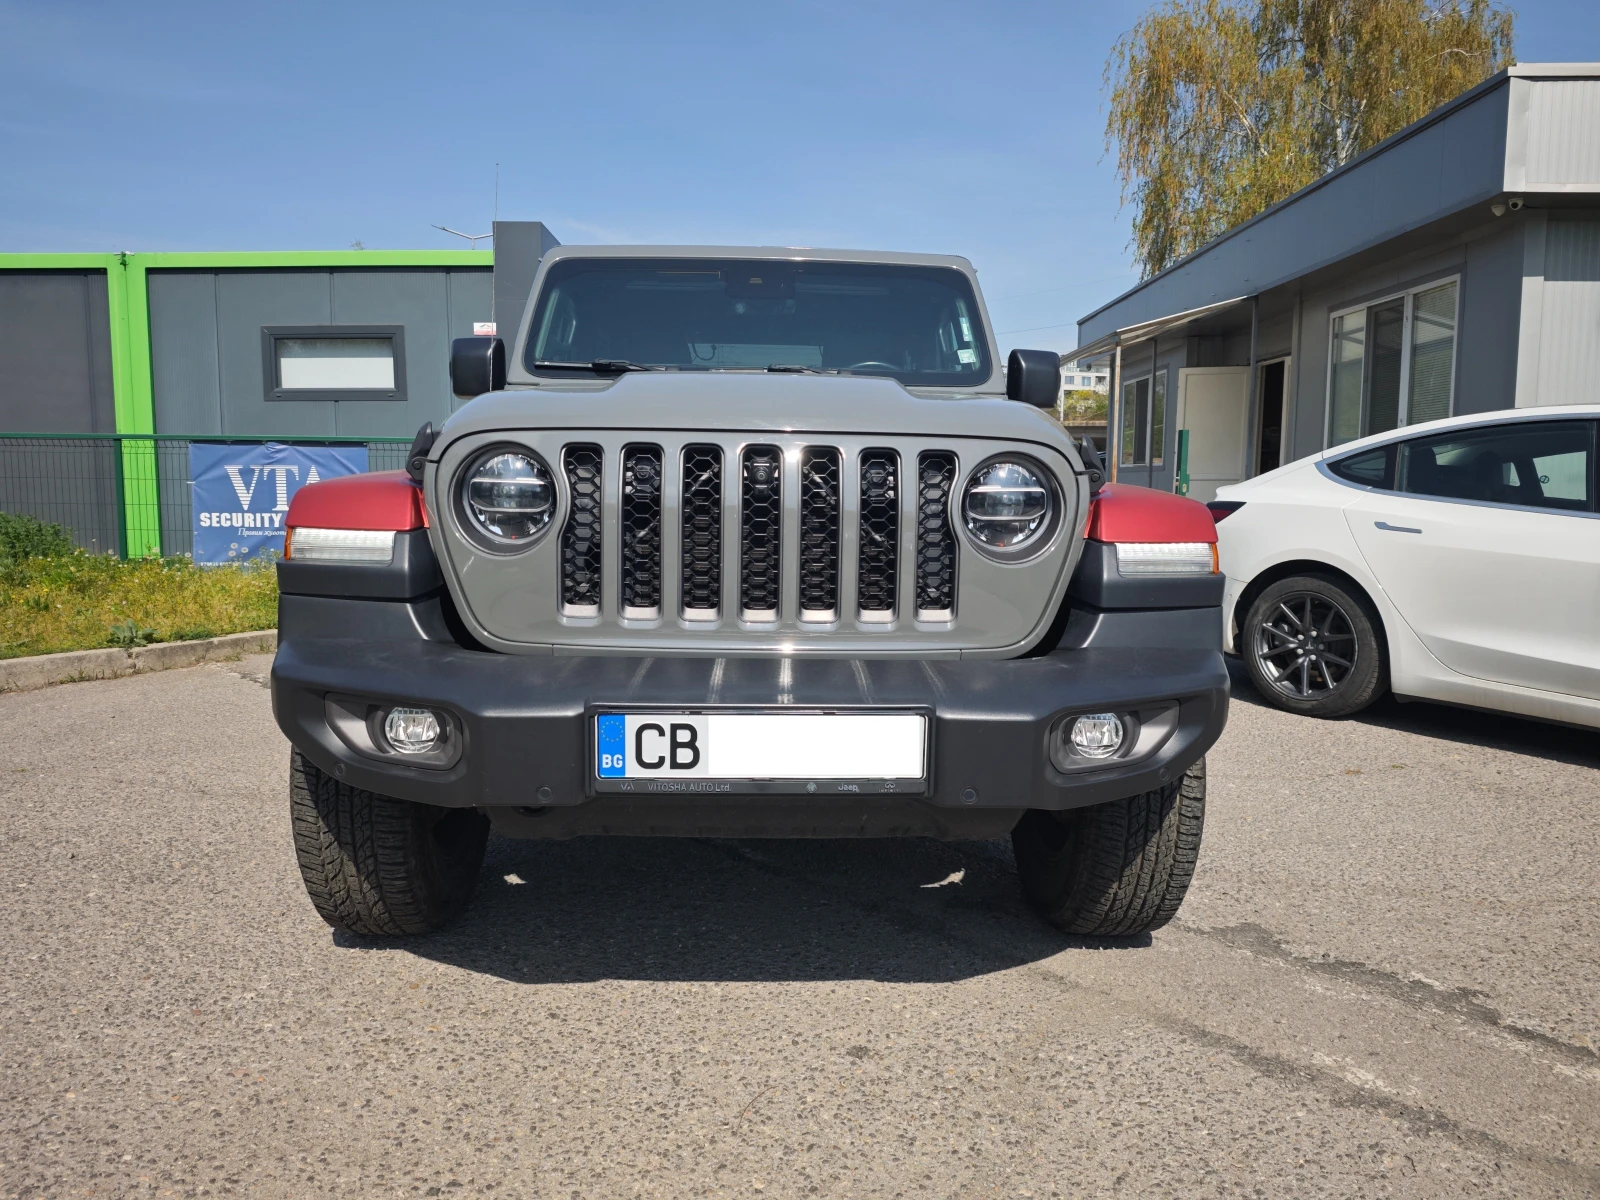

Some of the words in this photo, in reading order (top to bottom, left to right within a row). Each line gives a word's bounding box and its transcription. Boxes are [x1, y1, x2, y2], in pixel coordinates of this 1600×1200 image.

[200, 512, 282, 527] SECURITY
[635, 723, 700, 769] CB
[602, 754, 623, 768] BG
[647, 782, 687, 792] VITOSHA
[689, 782, 713, 792] AUTO
[715, 782, 732, 792] Ltd.
[838, 783, 859, 793] Jeep
